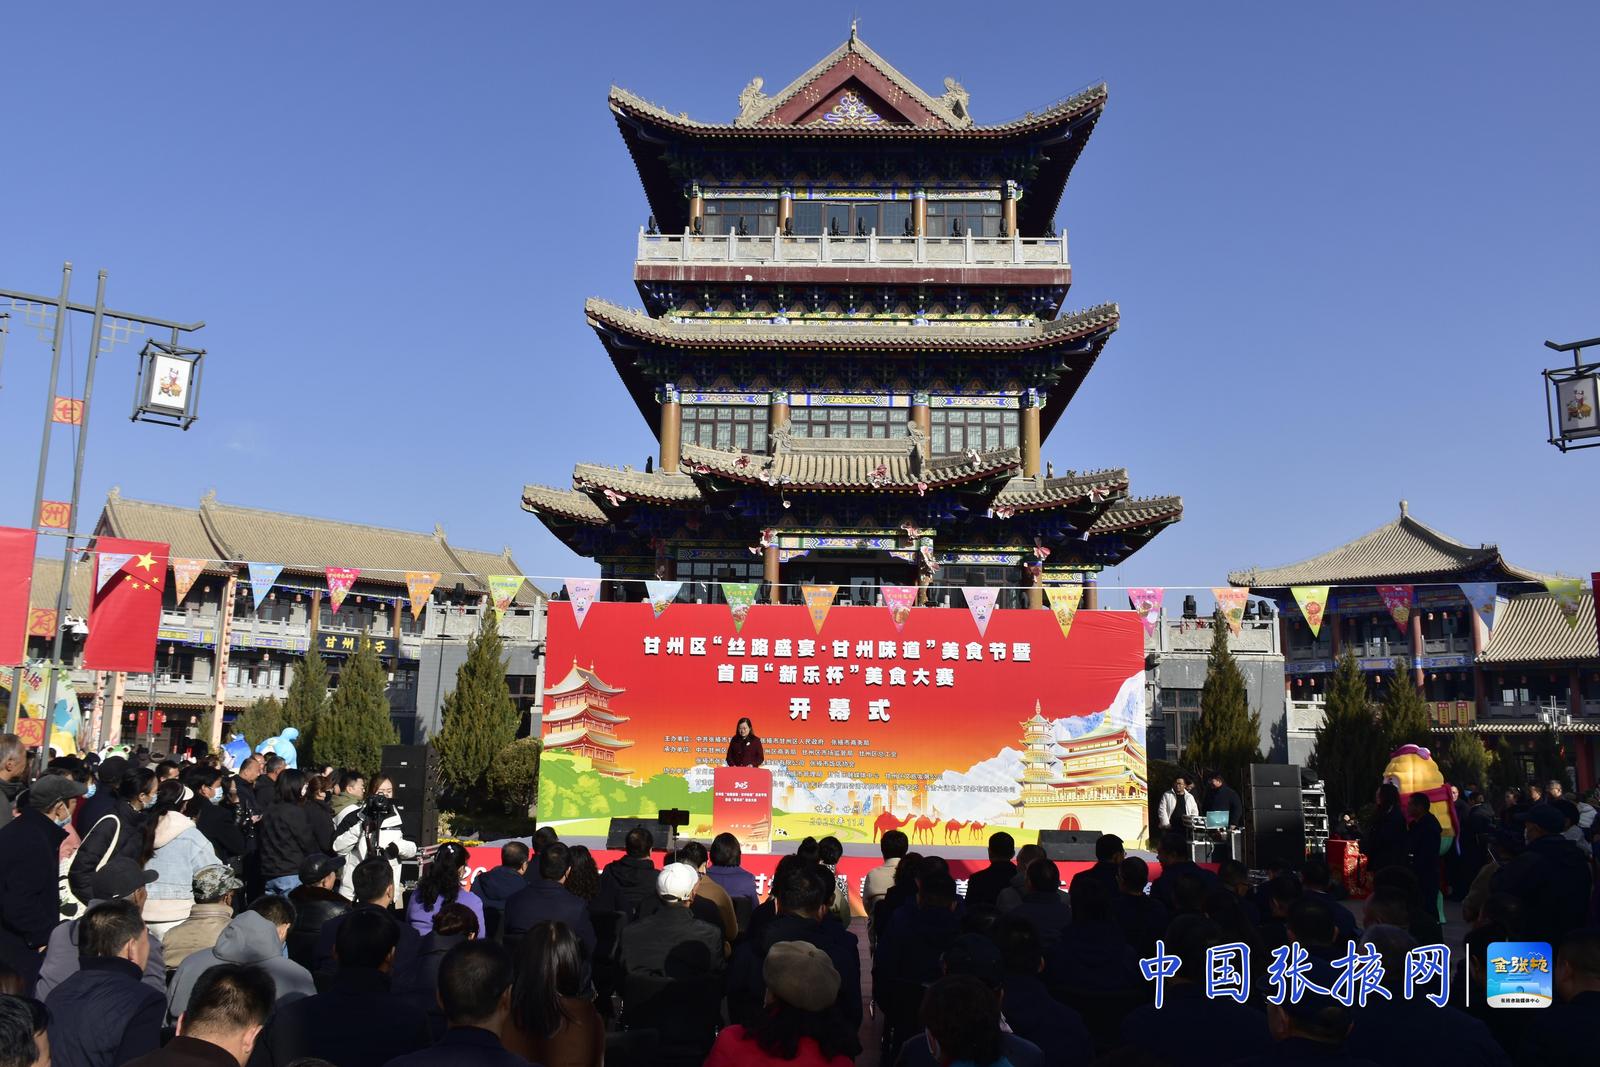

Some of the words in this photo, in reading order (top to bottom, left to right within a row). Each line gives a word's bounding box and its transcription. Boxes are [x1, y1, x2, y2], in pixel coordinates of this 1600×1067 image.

[325, 636, 387, 653] 甘州子
[643, 636, 1032, 662] 甘州区“丝路盛宴·甘州味道”美食节暨
[717, 663, 955, 687] 首届“新乐杯”美食大赛
